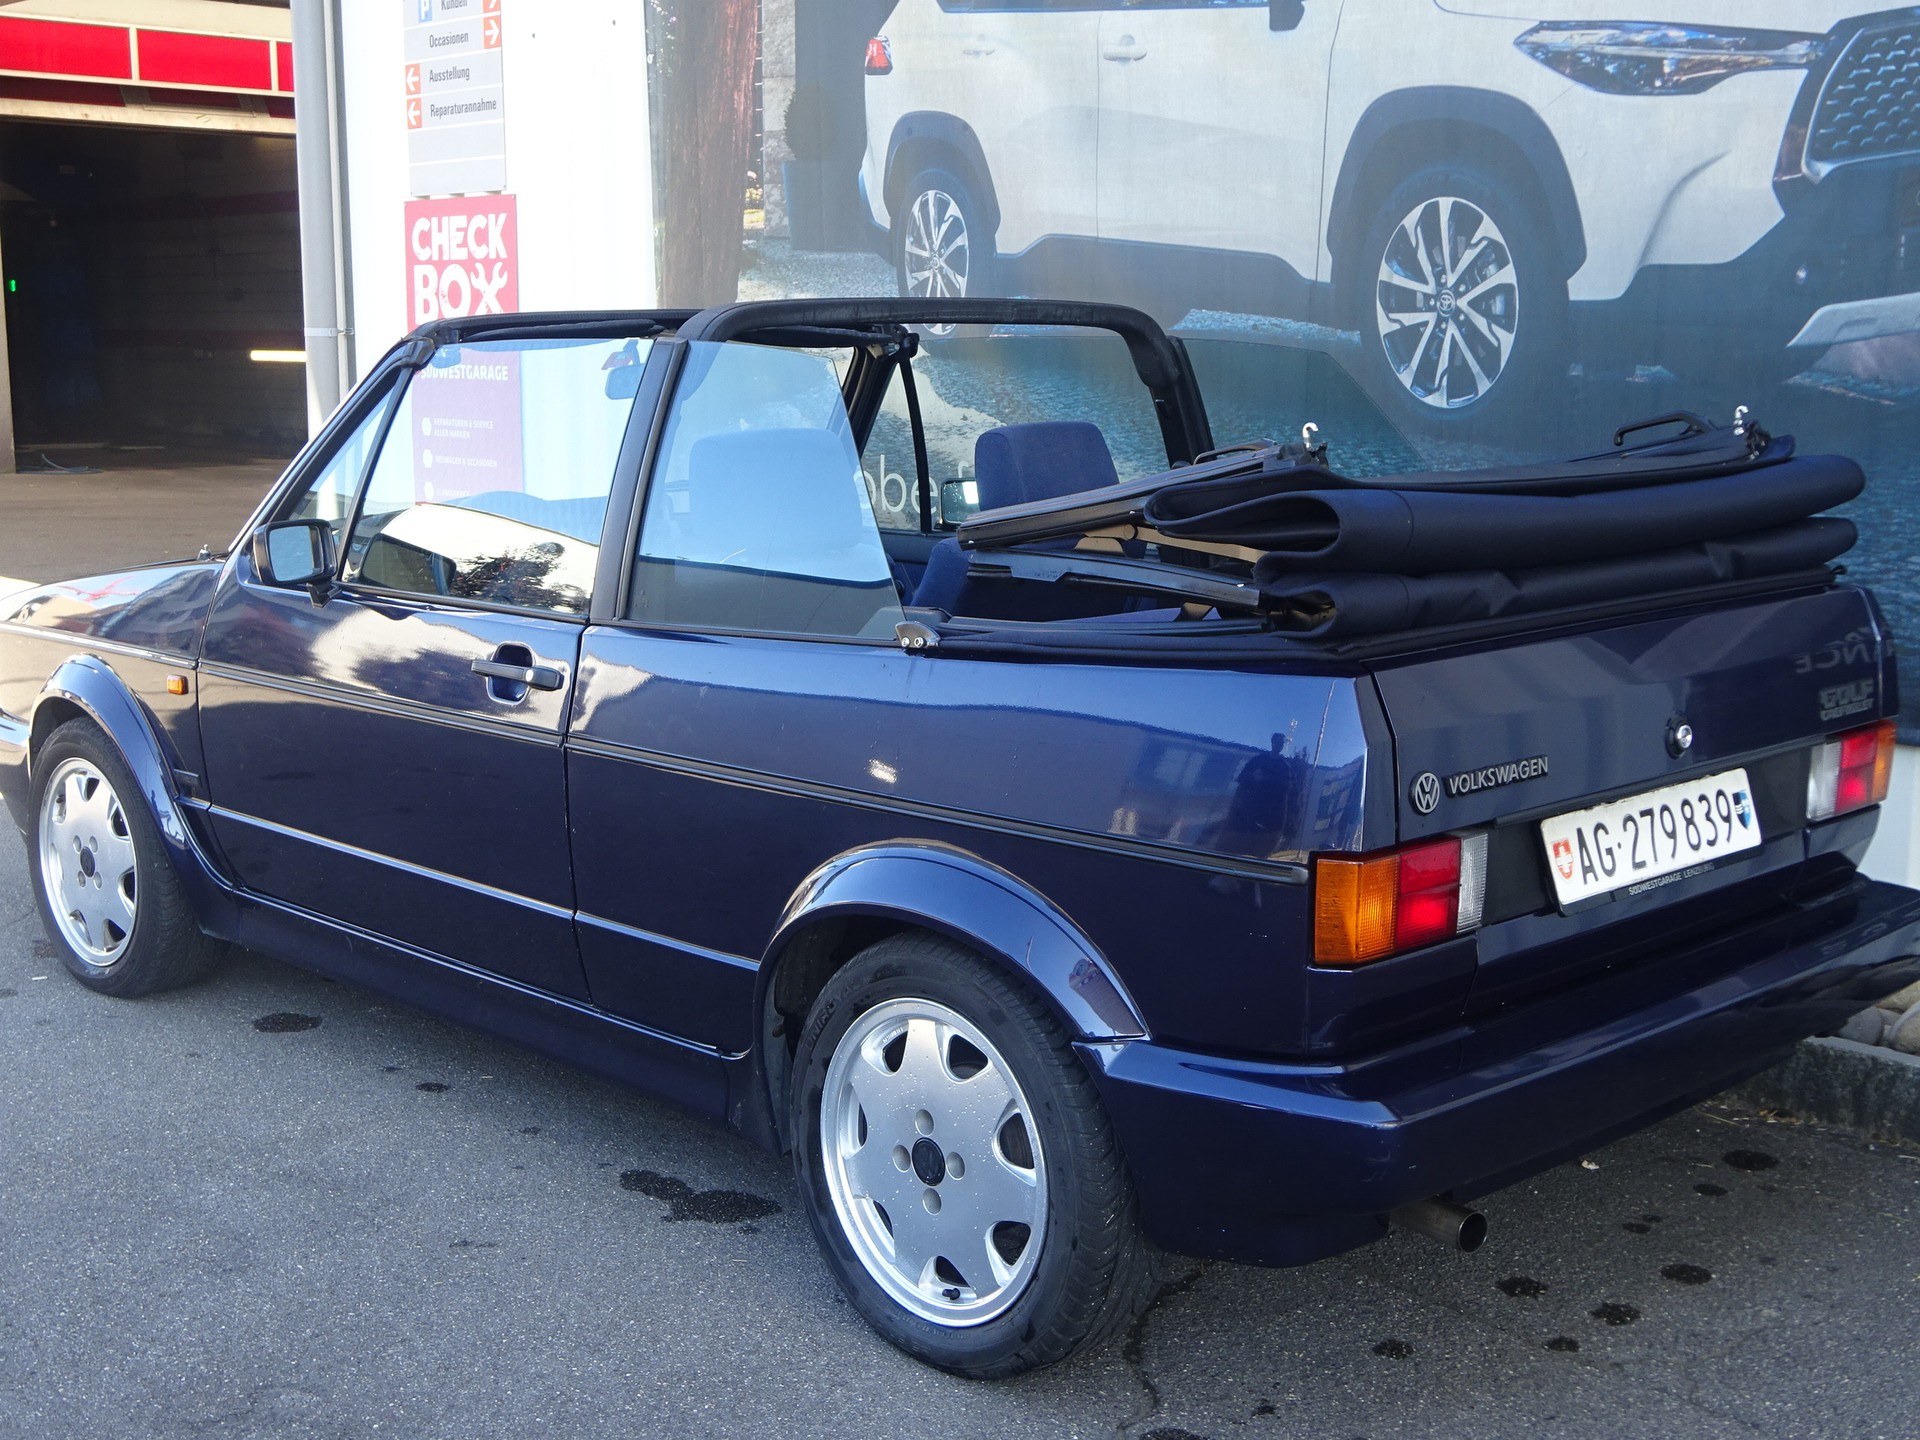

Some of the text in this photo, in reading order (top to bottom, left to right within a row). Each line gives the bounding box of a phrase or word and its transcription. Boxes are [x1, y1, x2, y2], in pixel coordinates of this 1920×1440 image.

[429, 32, 469, 48] Occasionen
[429, 66, 470, 83] Ausstellung
[430, 98, 497, 119] Reparaturannahme
[412, 213, 508, 261] CHECK
[413, 262, 508, 325] BOX
[1449, 756, 1548, 794] VOLKSWAGEN
